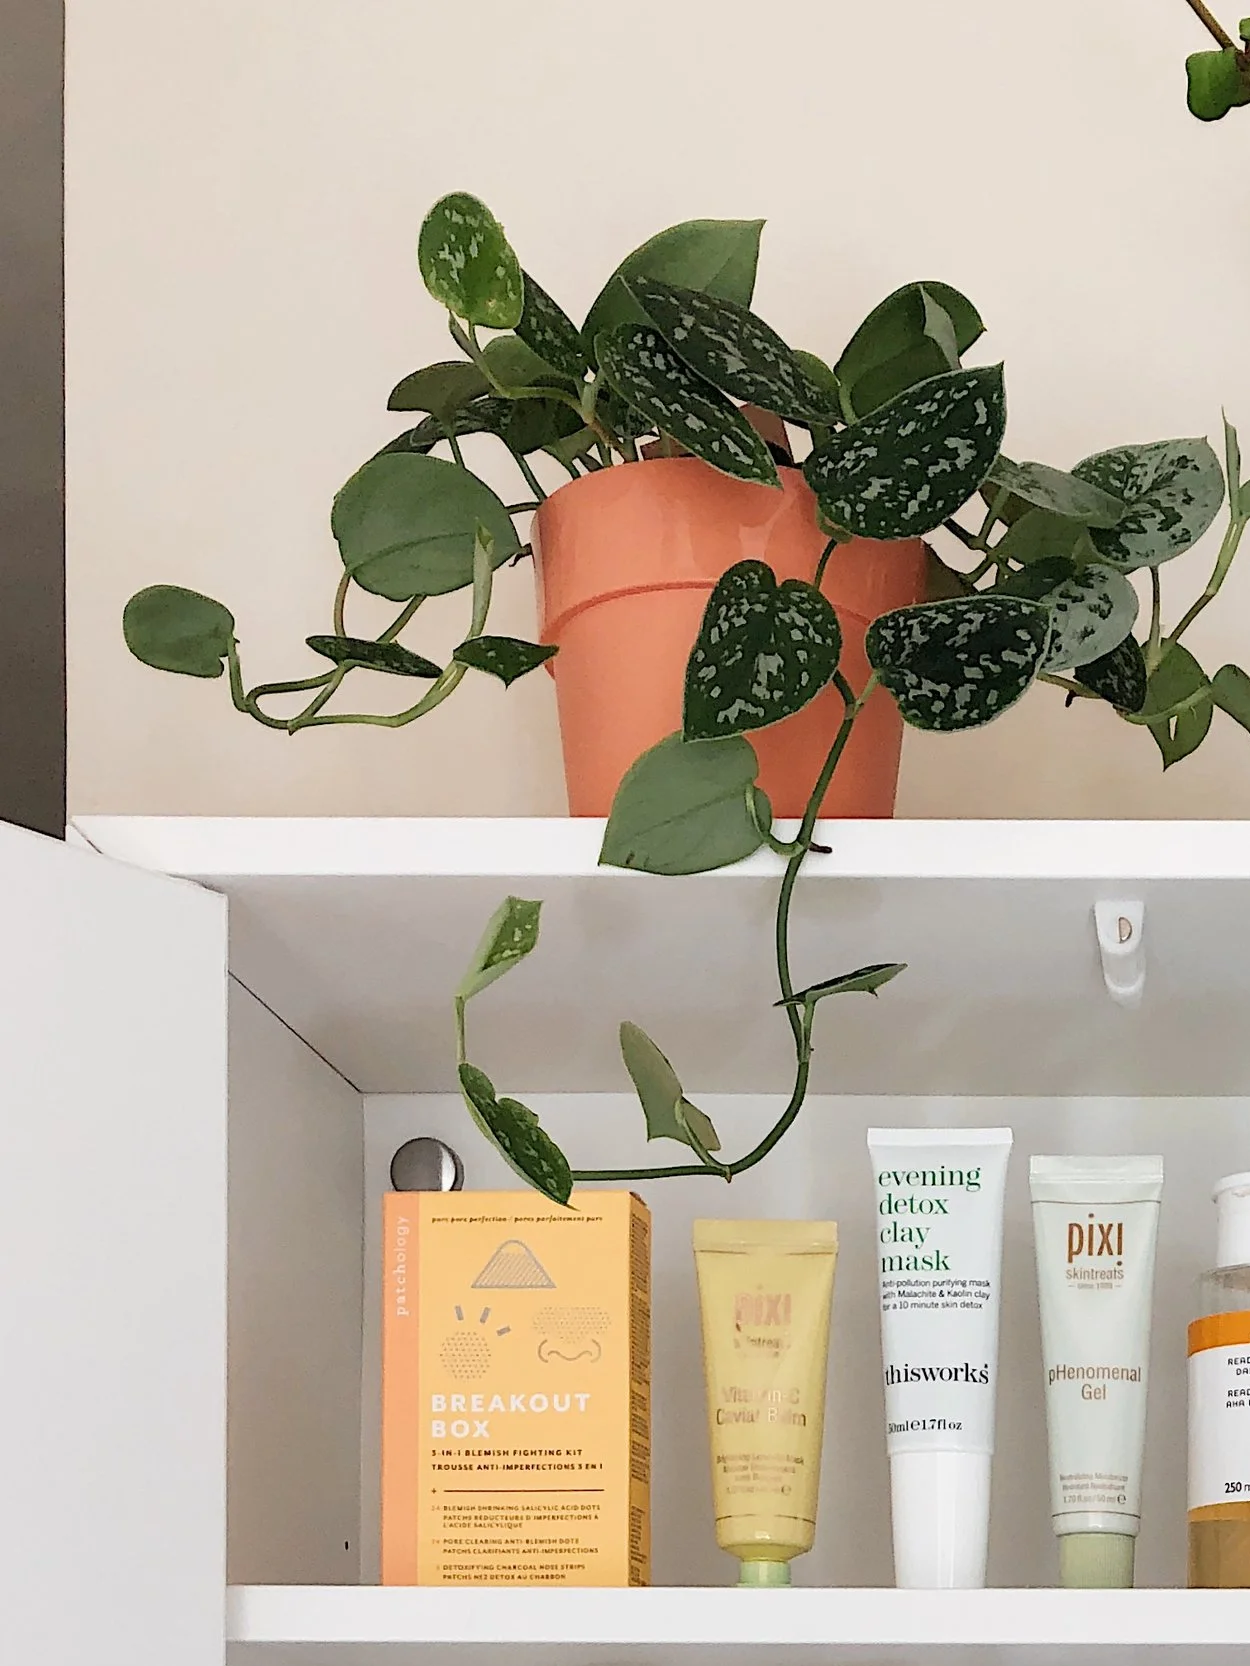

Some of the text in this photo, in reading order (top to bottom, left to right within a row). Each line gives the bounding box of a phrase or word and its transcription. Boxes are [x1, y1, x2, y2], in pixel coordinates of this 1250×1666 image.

[879, 1166, 981, 1192] evening
[880, 1193, 950, 1215] detox
[880, 1221, 930, 1249] clay
[393, 1215, 410, 1316] patchology
[882, 1250, 951, 1272] mask
[1066, 1268, 1124, 1280] skintreats
[933, 1279, 991, 1288] purifying mask
[974, 1291, 990, 1299] clay
[911, 1301, 939, 1309] minute
[960, 1301, 982, 1309] detox
[1049, 1364, 1141, 1385] pHenomenal
[1082, 1384, 1106, 1400] Gel
[432, 1394, 590, 1412] BREAKOUT
[432, 1420, 490, 1438] BOX
[1225, 1482, 1242, 1493] 250
